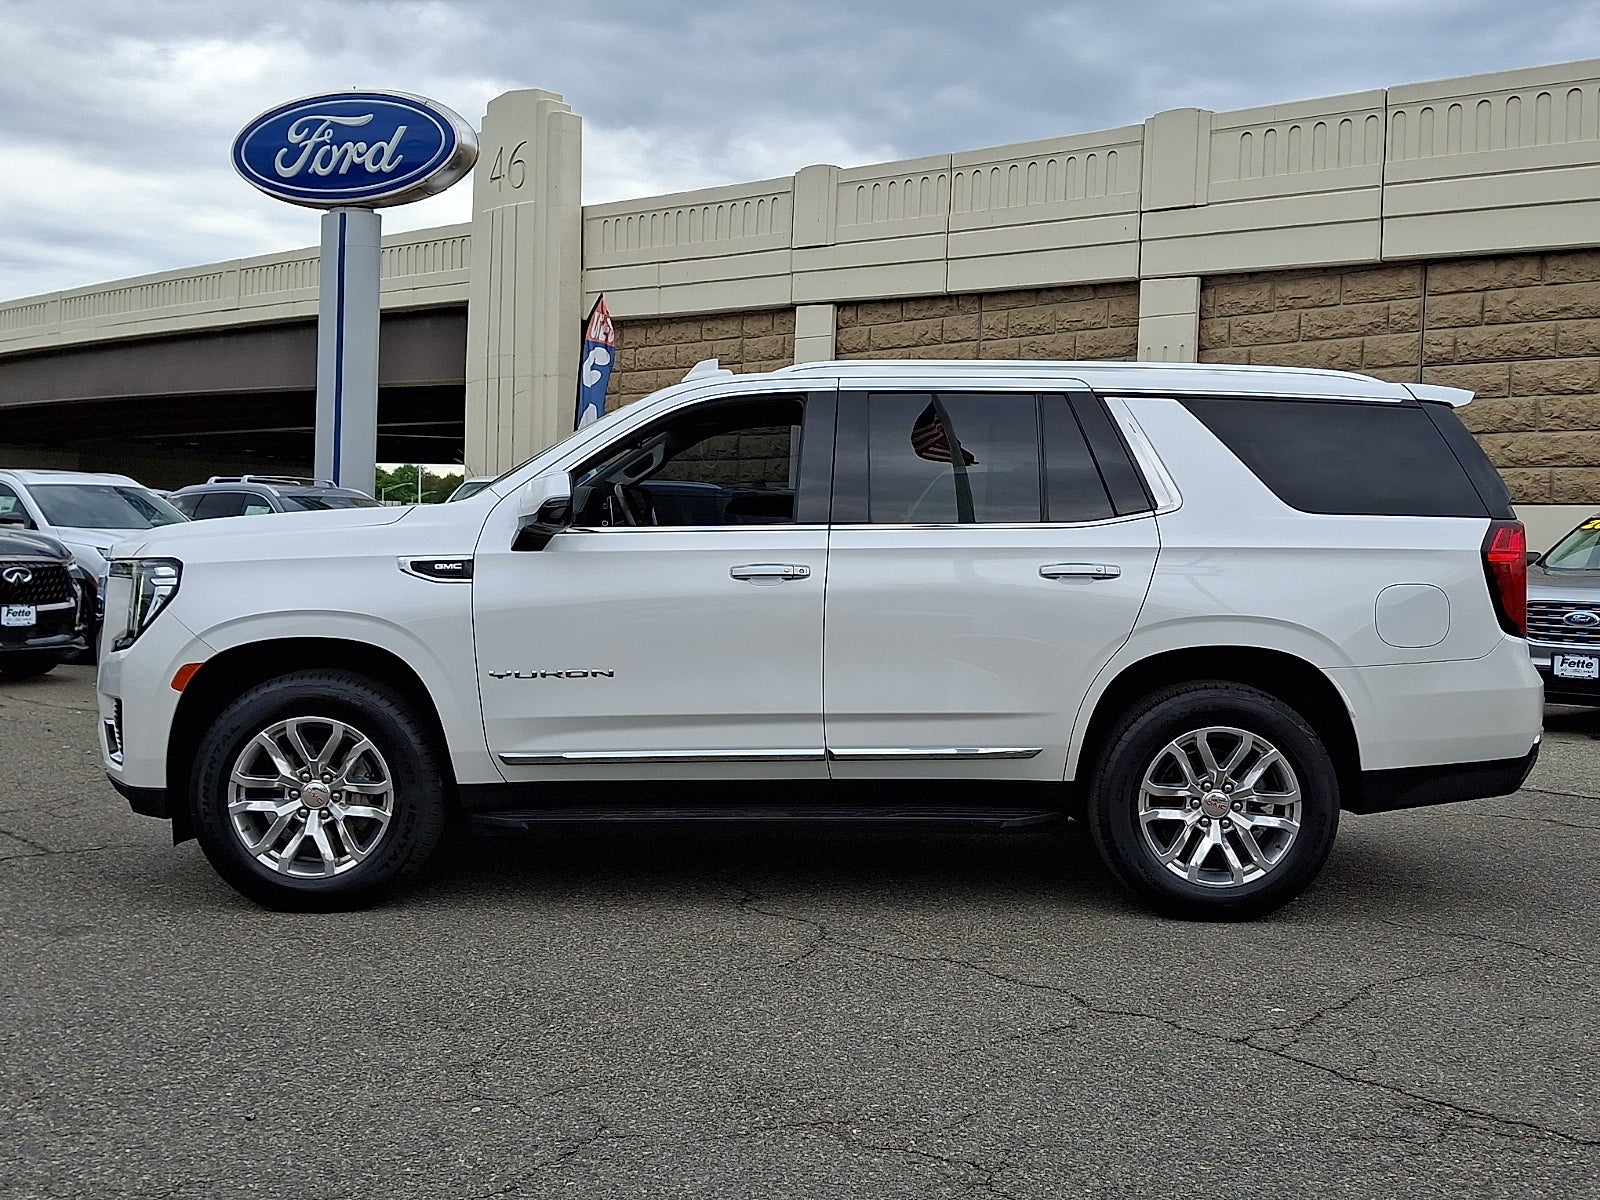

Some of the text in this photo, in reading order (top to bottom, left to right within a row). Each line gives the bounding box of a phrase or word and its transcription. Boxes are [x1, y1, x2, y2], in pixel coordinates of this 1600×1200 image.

[274, 113, 408, 178] Ford
[489, 140, 528, 193] 46
[434, 562, 463, 570] GMC
[1570, 613, 1591, 623] Ford
[1559, 657, 1594, 669] Fette
[488, 668, 615, 680] YUKON
[1205, 800, 1228, 811] GMC
